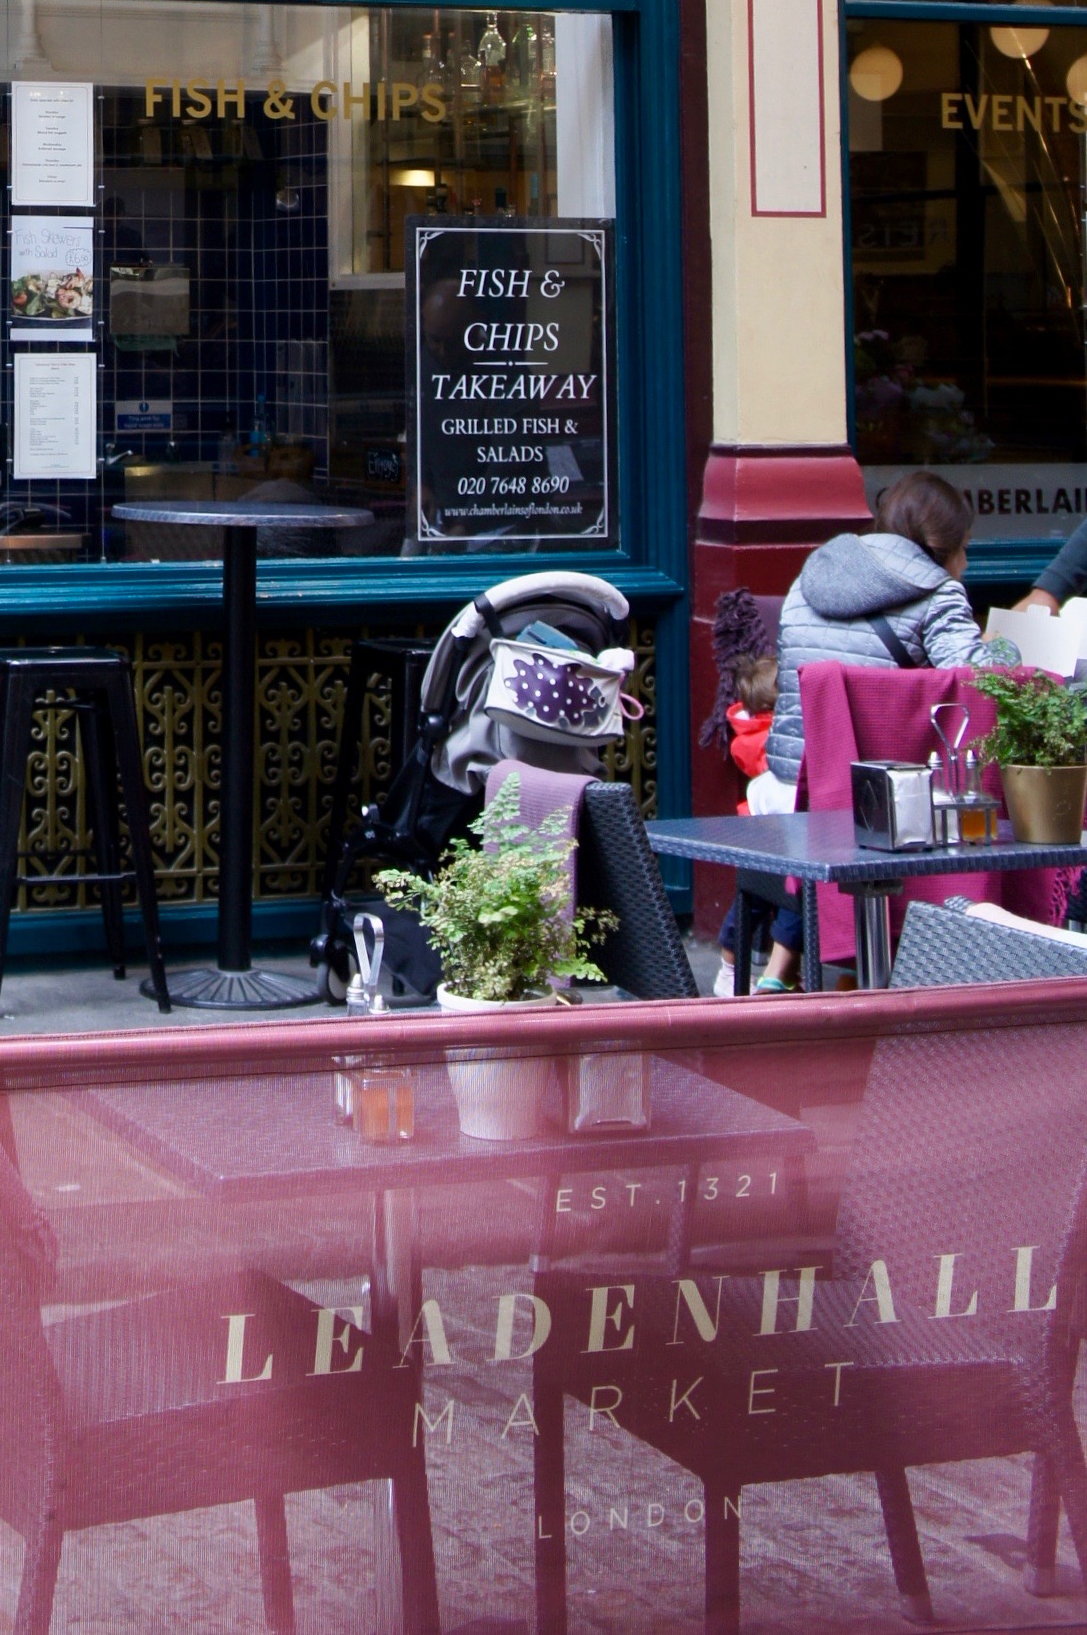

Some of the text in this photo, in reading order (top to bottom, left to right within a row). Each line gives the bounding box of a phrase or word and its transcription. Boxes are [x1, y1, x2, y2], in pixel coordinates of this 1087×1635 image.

[145, 77, 447, 122] FISH & CHIPS
[941, 92, 1087, 134] EVENTS
[35, 245, 58, 258] Salad
[456, 269, 565, 297] FISH &
[464, 322, 559, 351] CHIPS
[431, 374, 597, 400] TAKEAWAY
[441, 418, 579, 435] GRILLED FISH &
[477, 445, 544, 463] SALADS
[457, 475, 569, 495] 020 7648 8690
[444, 502, 583, 518] www.chamberlainsoflondon.co.uk
[215, 1244, 1059, 1385] LEADENHALL
[411, 1361, 856, 1449] MARKET
[538, 1495, 742, 1539] LONDON
